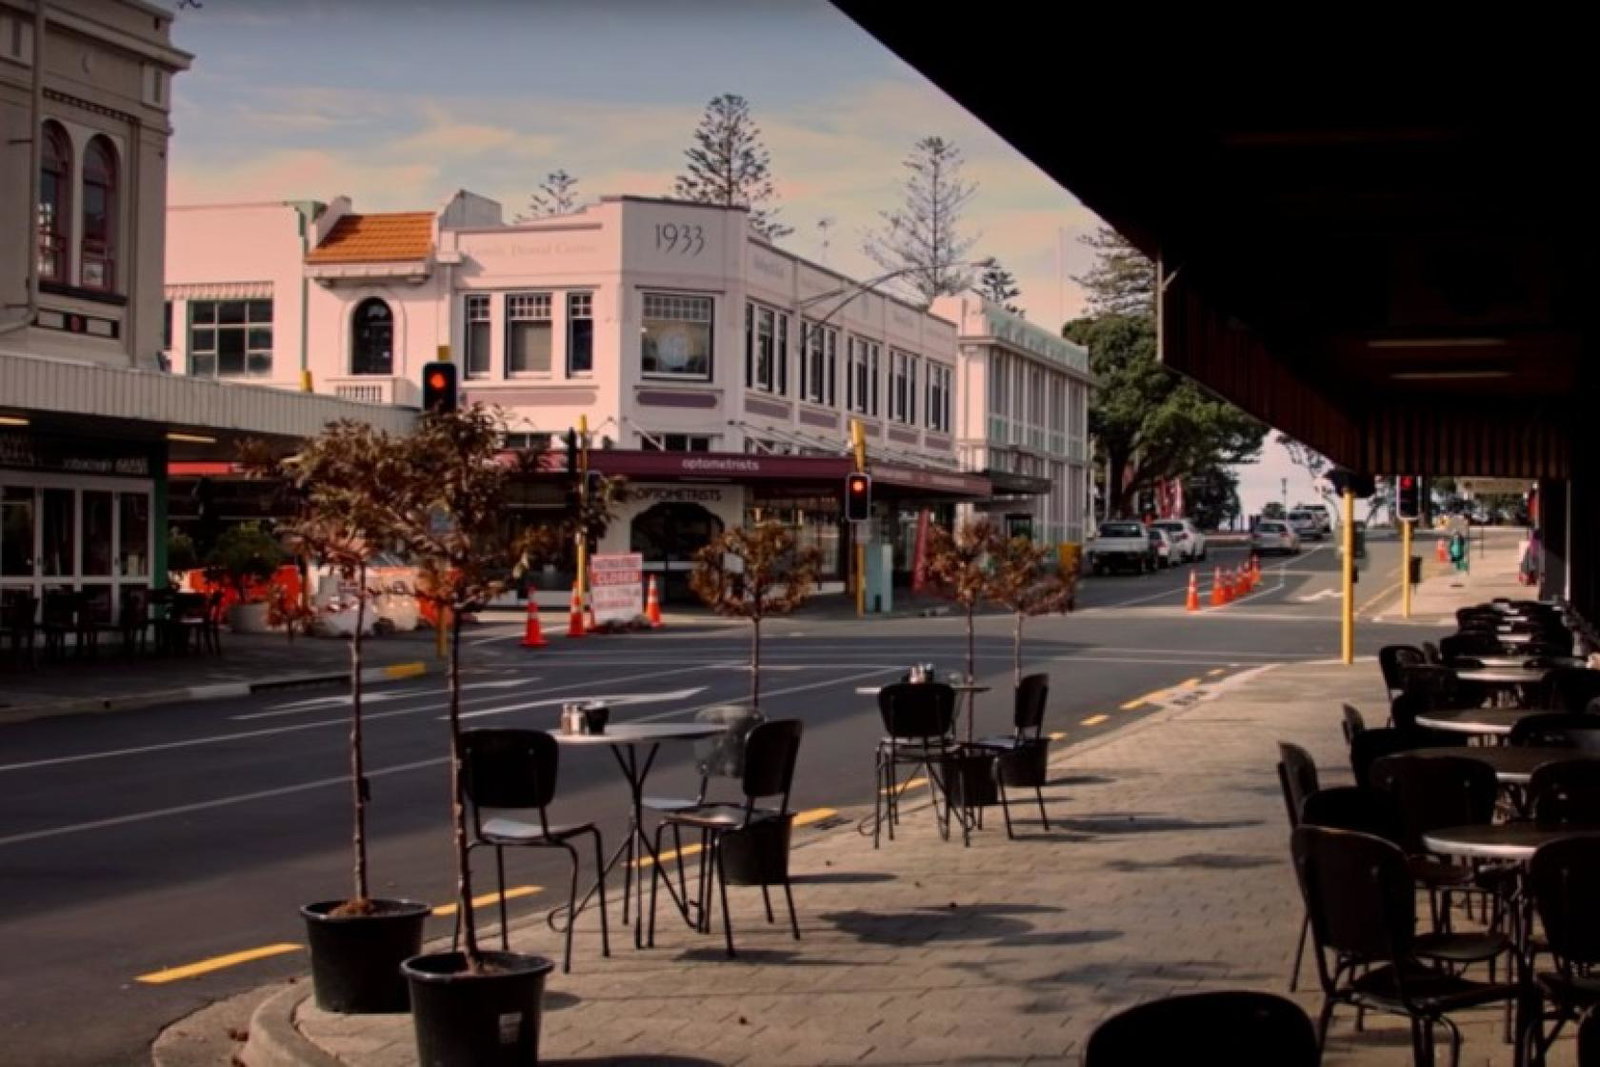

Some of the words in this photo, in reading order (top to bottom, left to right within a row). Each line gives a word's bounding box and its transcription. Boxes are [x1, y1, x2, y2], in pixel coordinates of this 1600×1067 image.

[655, 222, 705, 256] 1933
[682, 458, 760, 471] optometrists
[636, 487, 721, 502] OPTOMETRISTS
